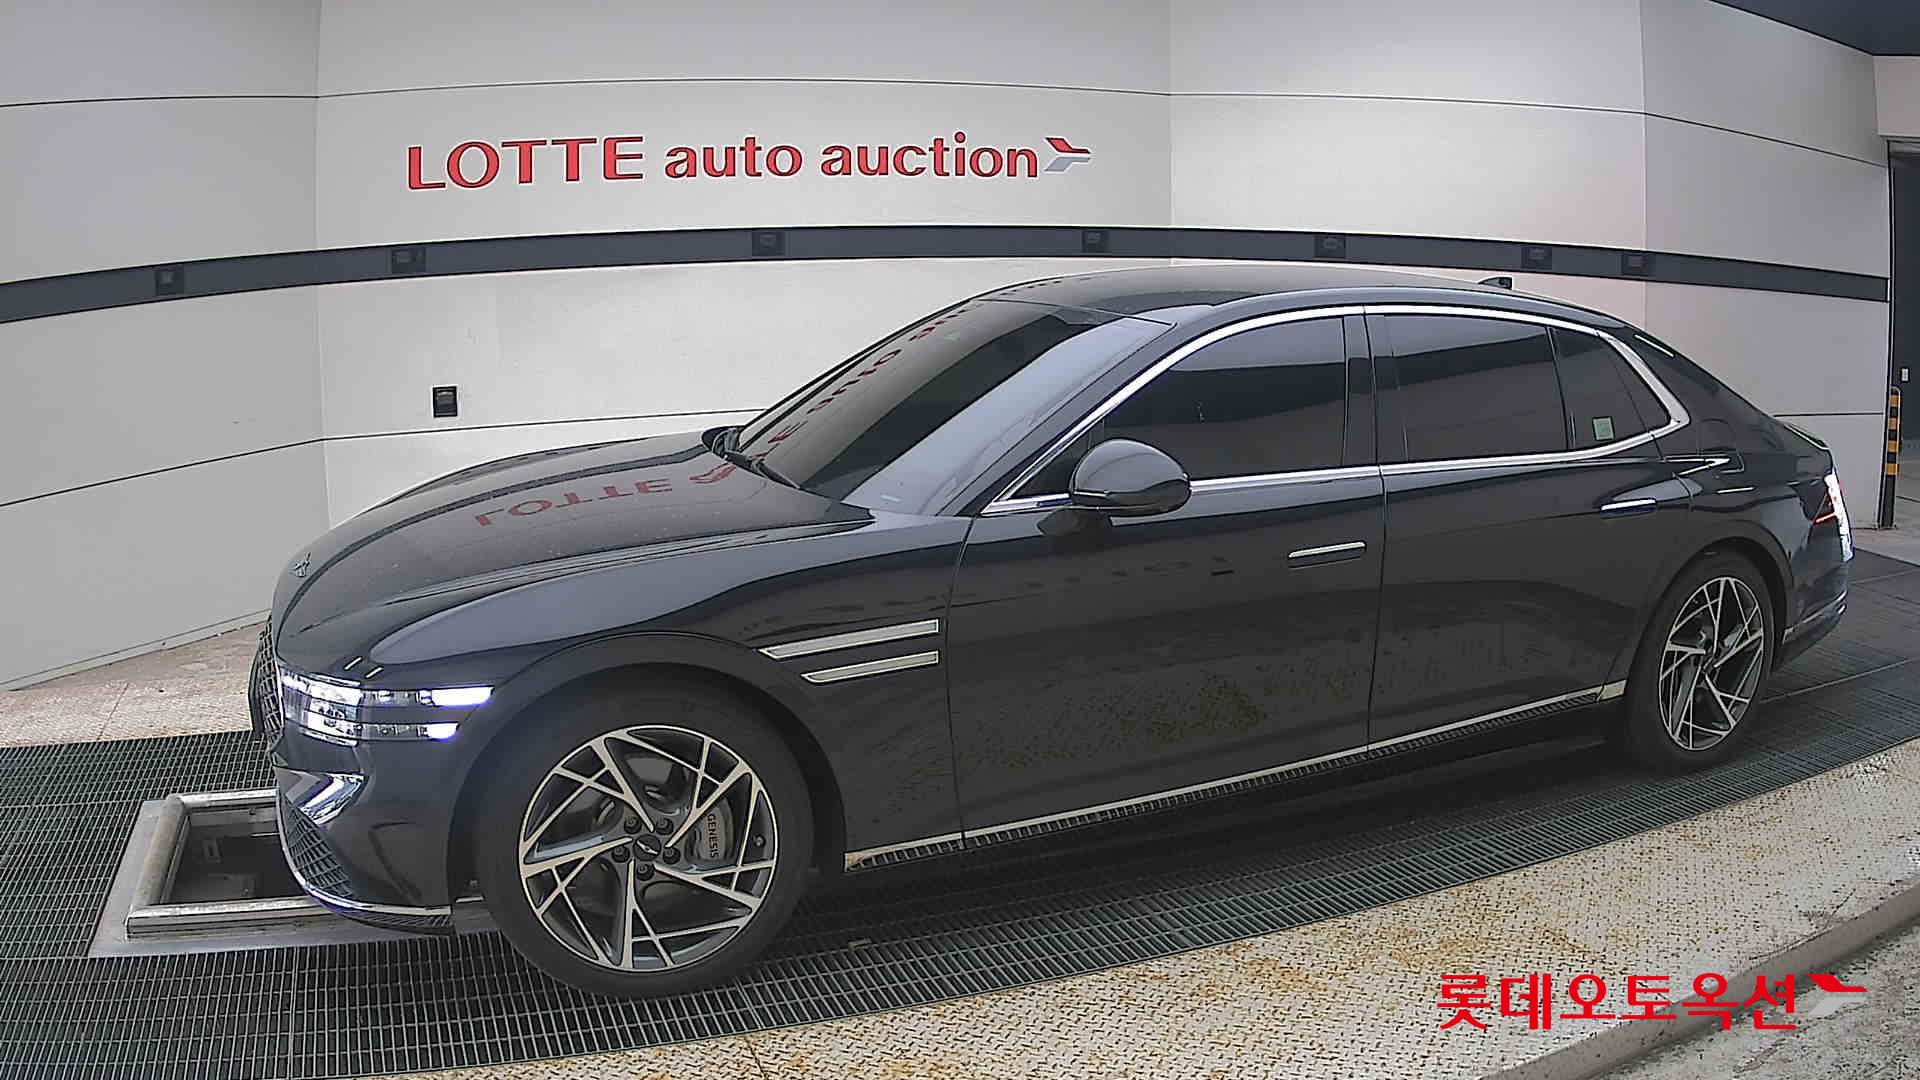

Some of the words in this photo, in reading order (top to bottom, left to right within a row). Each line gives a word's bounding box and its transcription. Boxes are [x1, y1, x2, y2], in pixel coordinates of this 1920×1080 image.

[407, 136, 645, 190] LOTTE
[664, 136, 804, 178] auto
[821, 132, 1039, 178] auction
[707, 813, 720, 858] GENESIS
